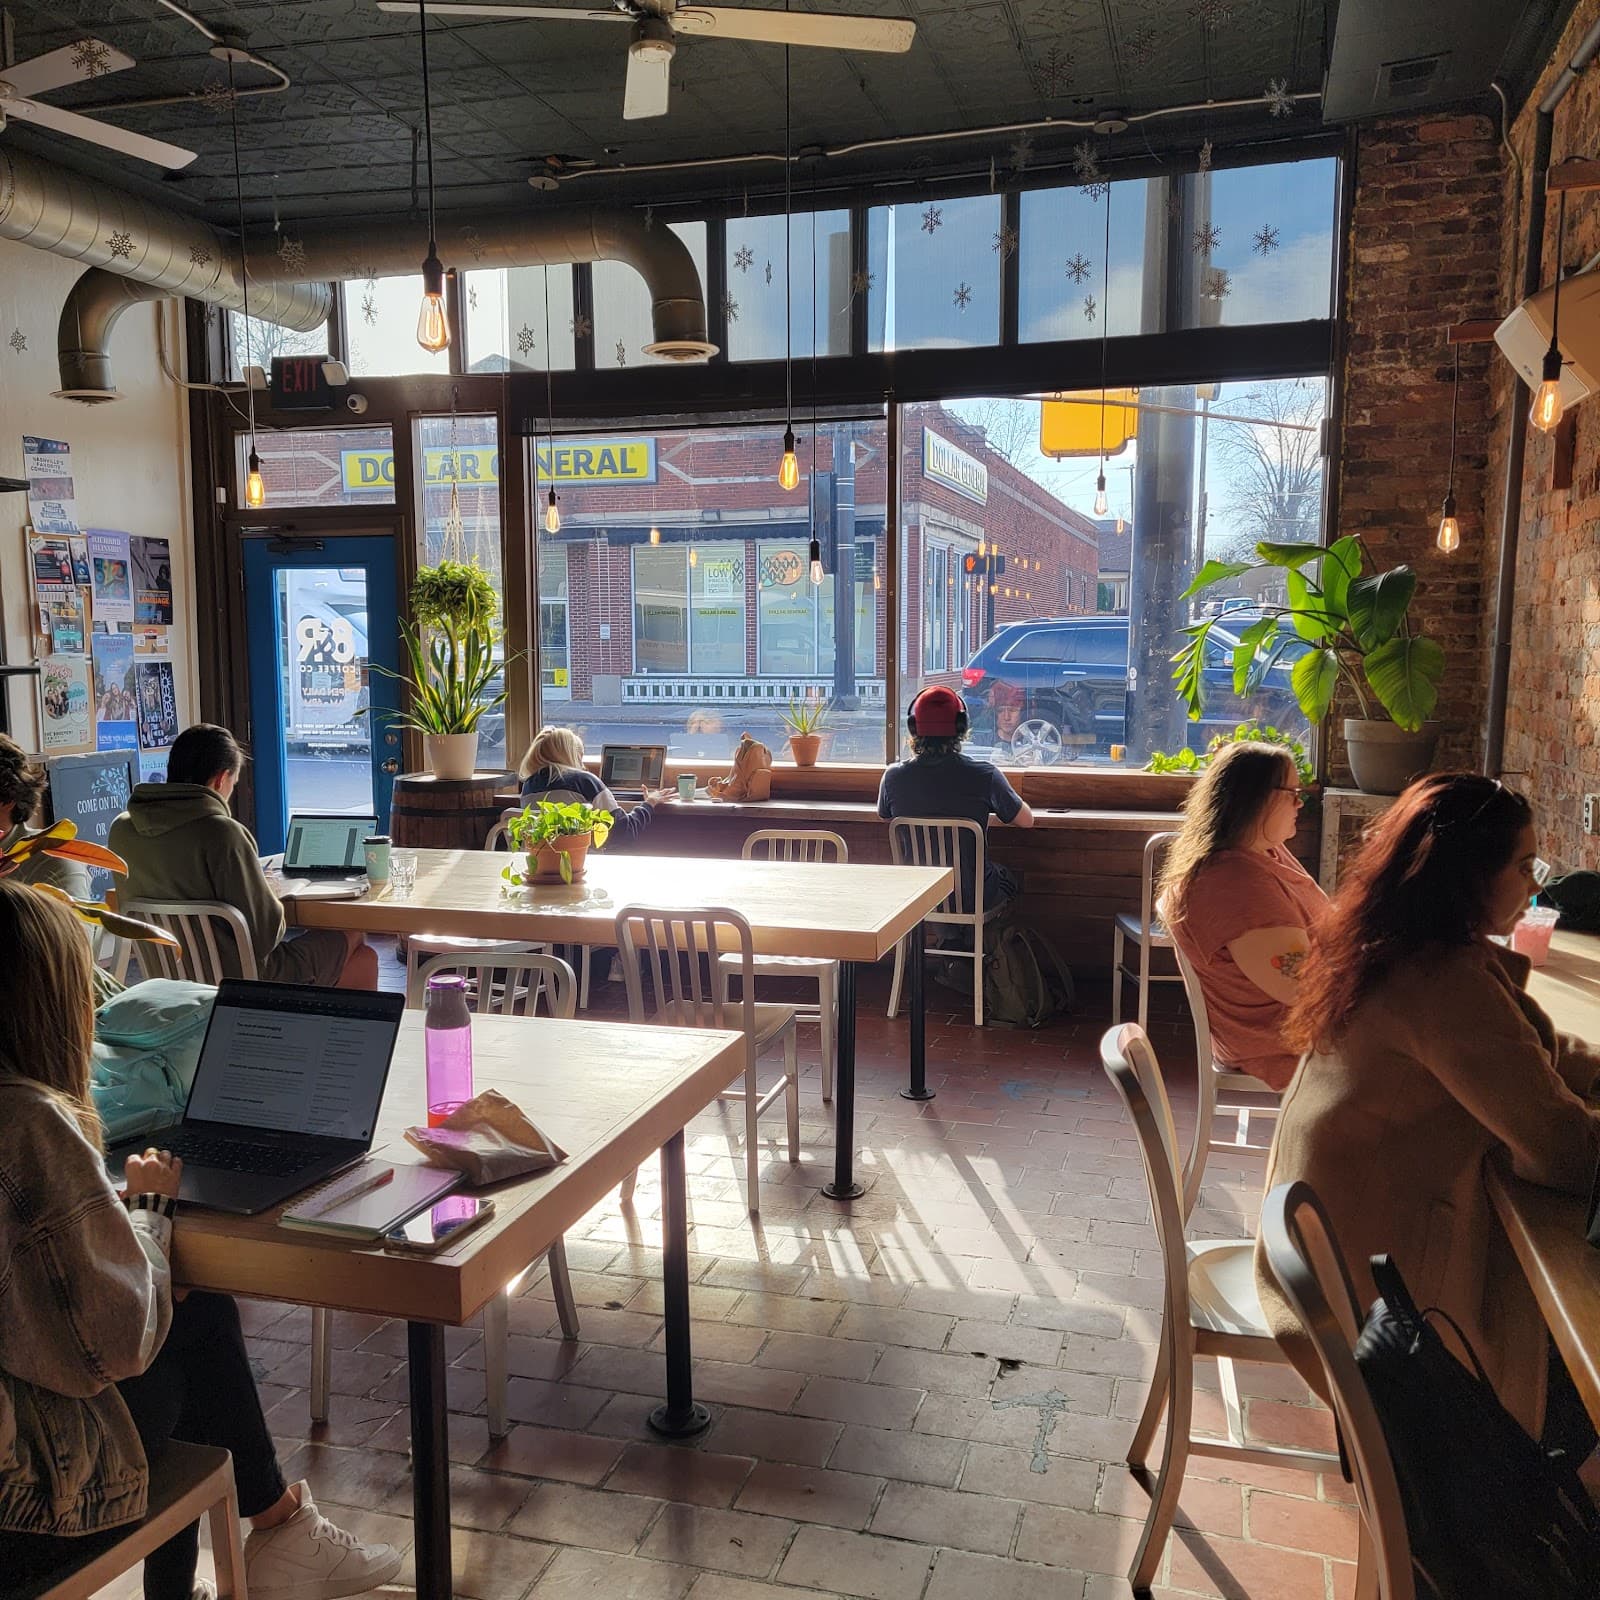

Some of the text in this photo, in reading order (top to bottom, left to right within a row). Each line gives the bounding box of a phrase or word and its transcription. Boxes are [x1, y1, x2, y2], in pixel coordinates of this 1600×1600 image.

[282, 359, 320, 392] EXIT
[358, 447, 637, 483] DOLAR NERAL
[933, 440, 986, 495] DOLLAR GENERAL
[708, 567, 729, 577] LOW
[77, 795, 119, 814] COME ON IN
[96, 823, 107, 836] OR
